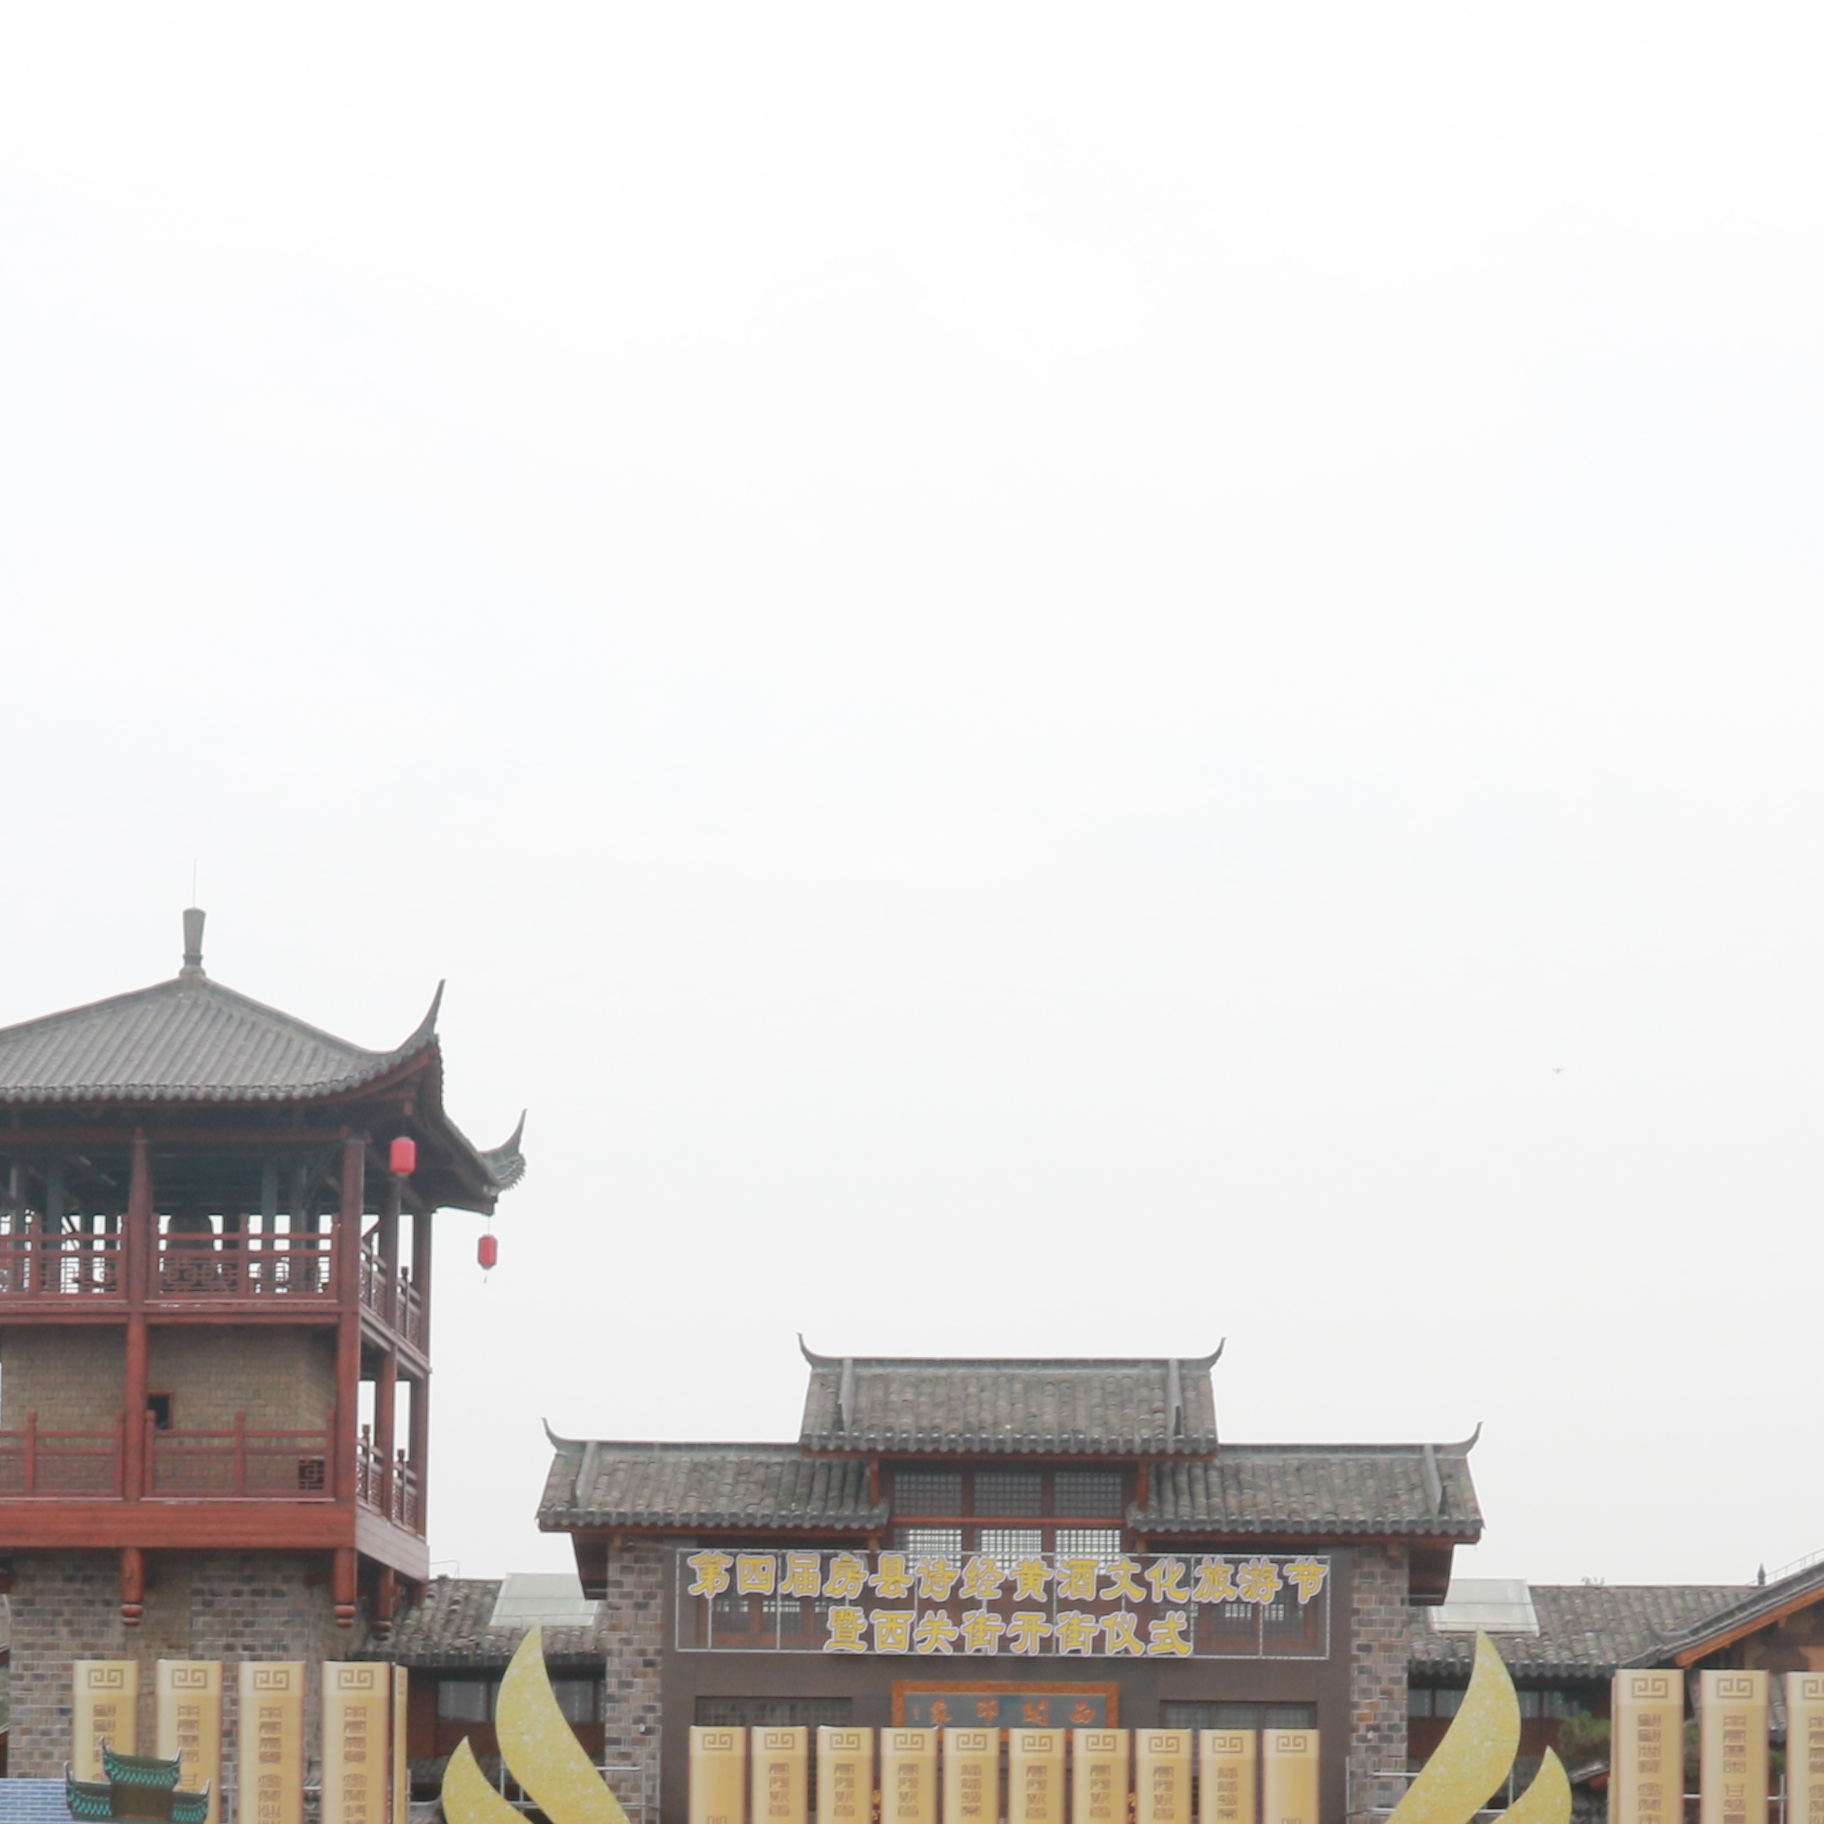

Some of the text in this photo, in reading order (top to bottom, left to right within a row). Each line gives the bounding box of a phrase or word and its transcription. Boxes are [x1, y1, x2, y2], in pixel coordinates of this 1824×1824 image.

[687, 1551, 1329, 1604] 第四届房县诗经黄酒文化旅游节
[823, 1606, 1193, 1657] 暨西关街开街仪式
